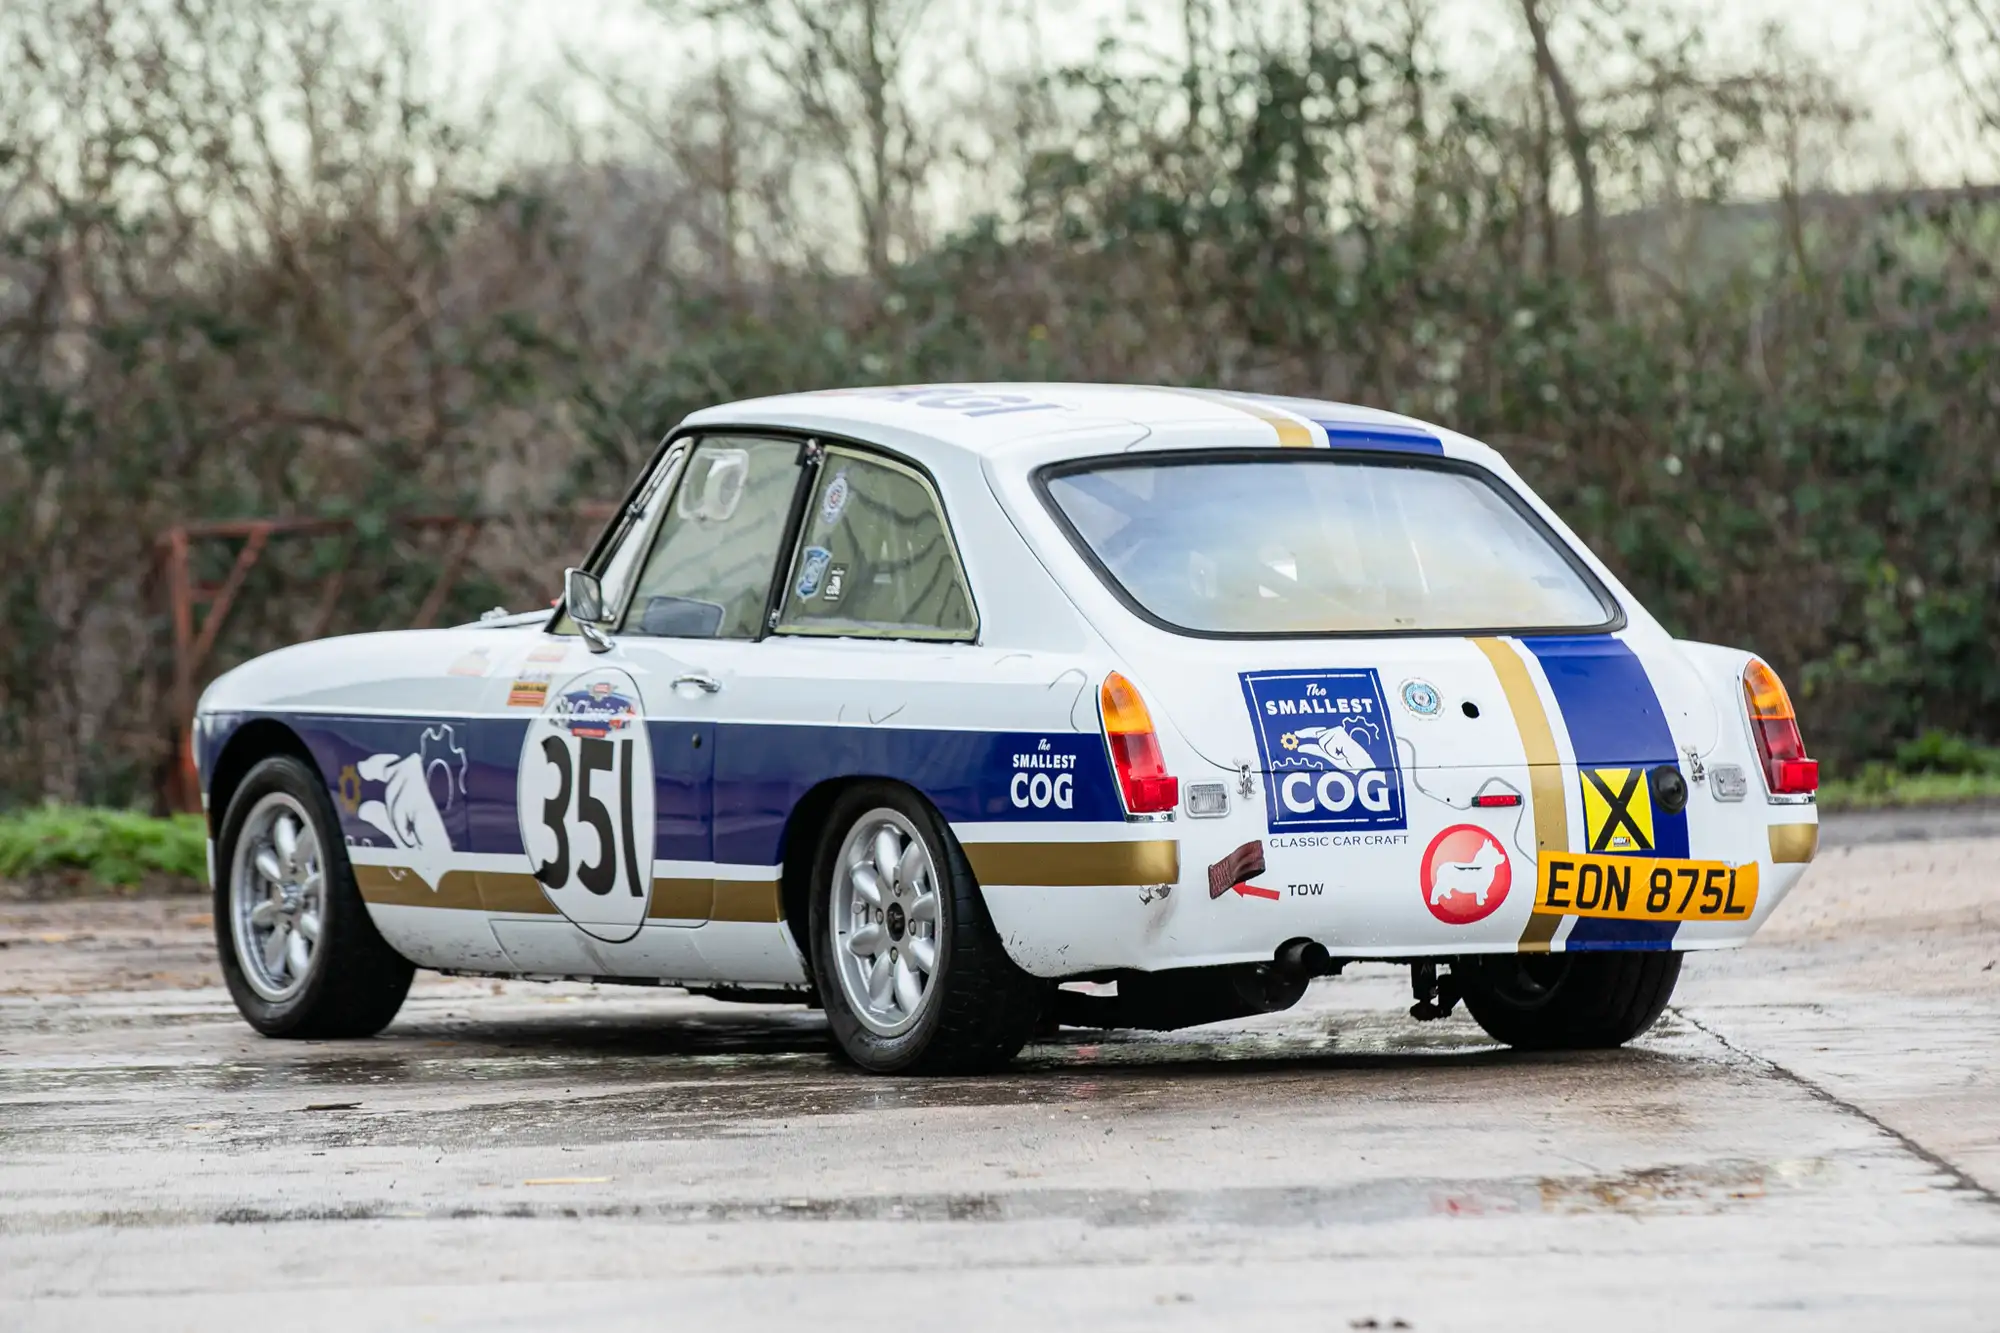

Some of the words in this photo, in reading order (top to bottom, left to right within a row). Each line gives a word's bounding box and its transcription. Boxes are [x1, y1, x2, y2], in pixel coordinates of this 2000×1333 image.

[1306, 683, 1327, 697] The
[1265, 698, 1373, 716] SMALLEST
[1038, 738, 1051, 751] The
[1012, 753, 1077, 769] SMALLEST
[1010, 772, 1073, 810] COG
[1281, 770, 1391, 814] COG
[533, 735, 644, 897] 351
[1269, 836, 1329, 848] CLASSIC
[1332, 835, 1361, 847] CAR
[1364, 835, 1409, 846] CRAFT
[1288, 883, 1324, 896] TOW
[1545, 860, 1632, 912] EON
[1646, 867, 1746, 915] 875L
